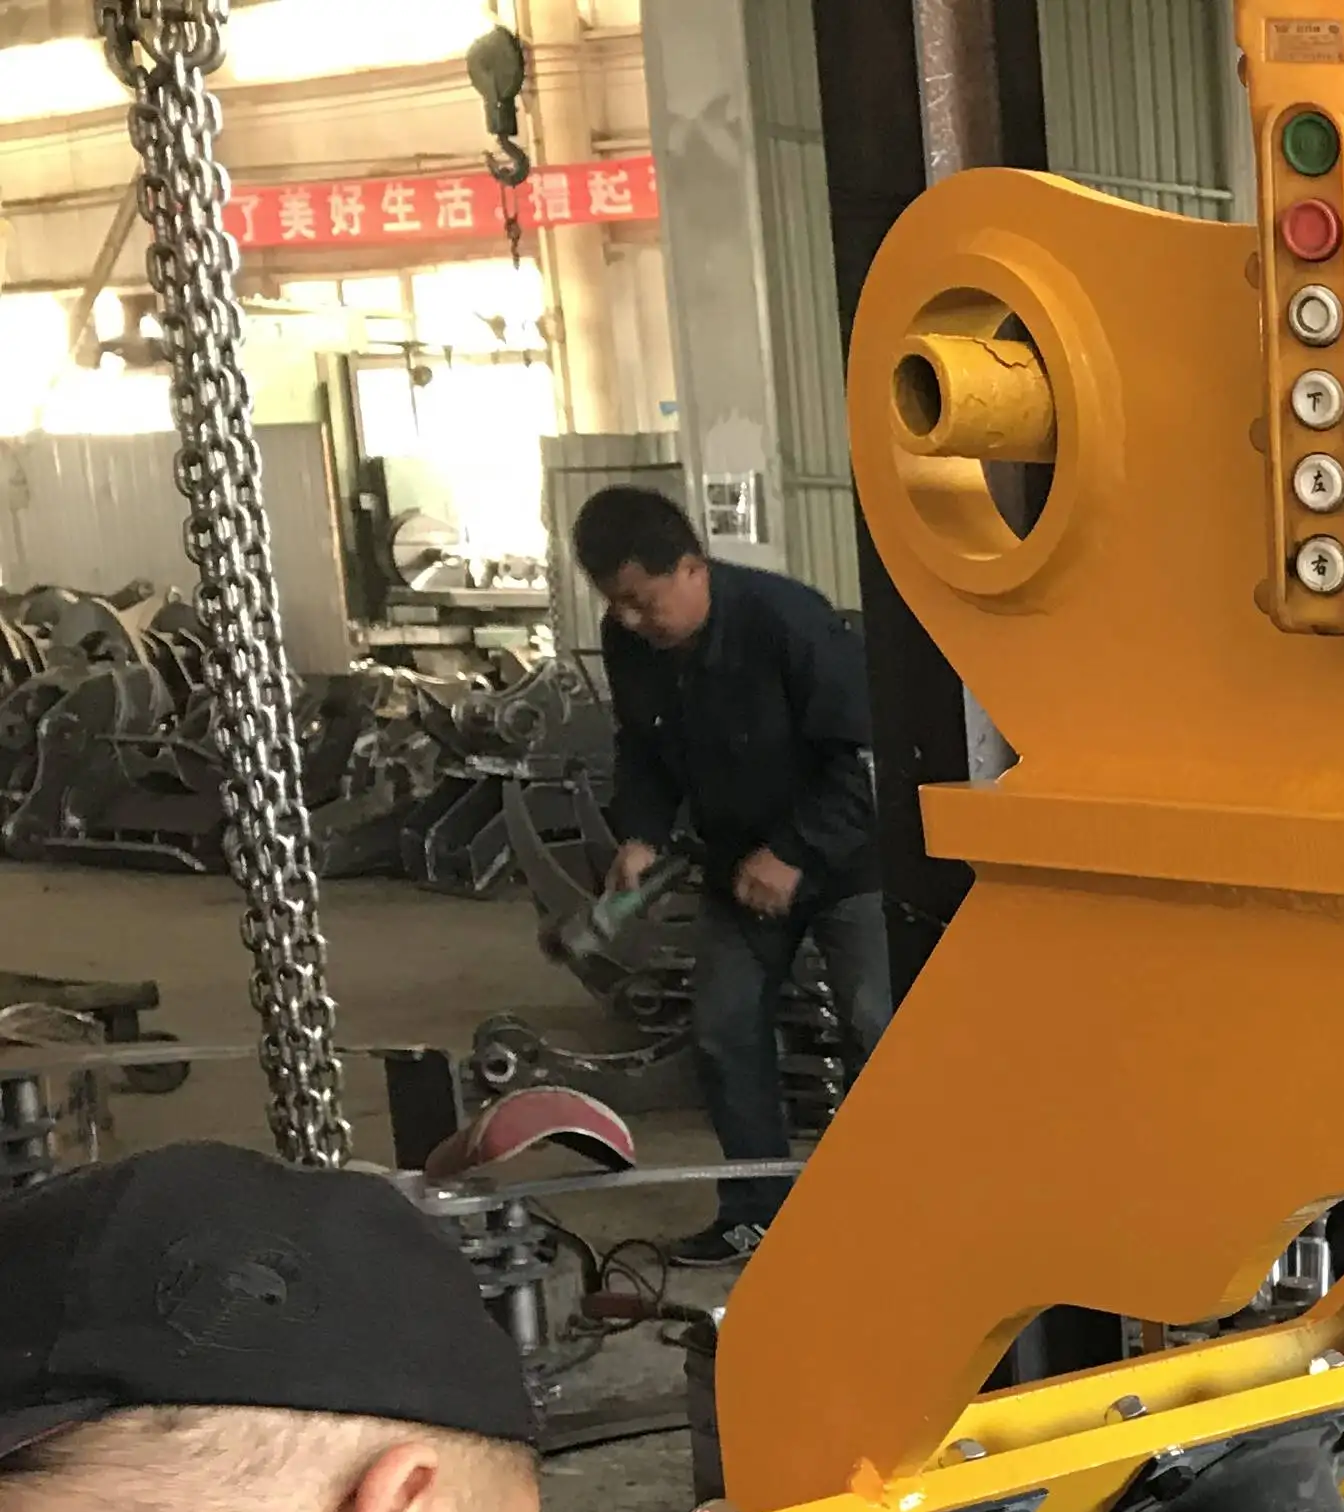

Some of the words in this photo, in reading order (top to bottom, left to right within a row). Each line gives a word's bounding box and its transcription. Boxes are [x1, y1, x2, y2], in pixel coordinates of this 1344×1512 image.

[1306, 391, 1324, 413] 下
[1310, 469, 1327, 495] 左
[1310, 554, 1329, 578] 右
